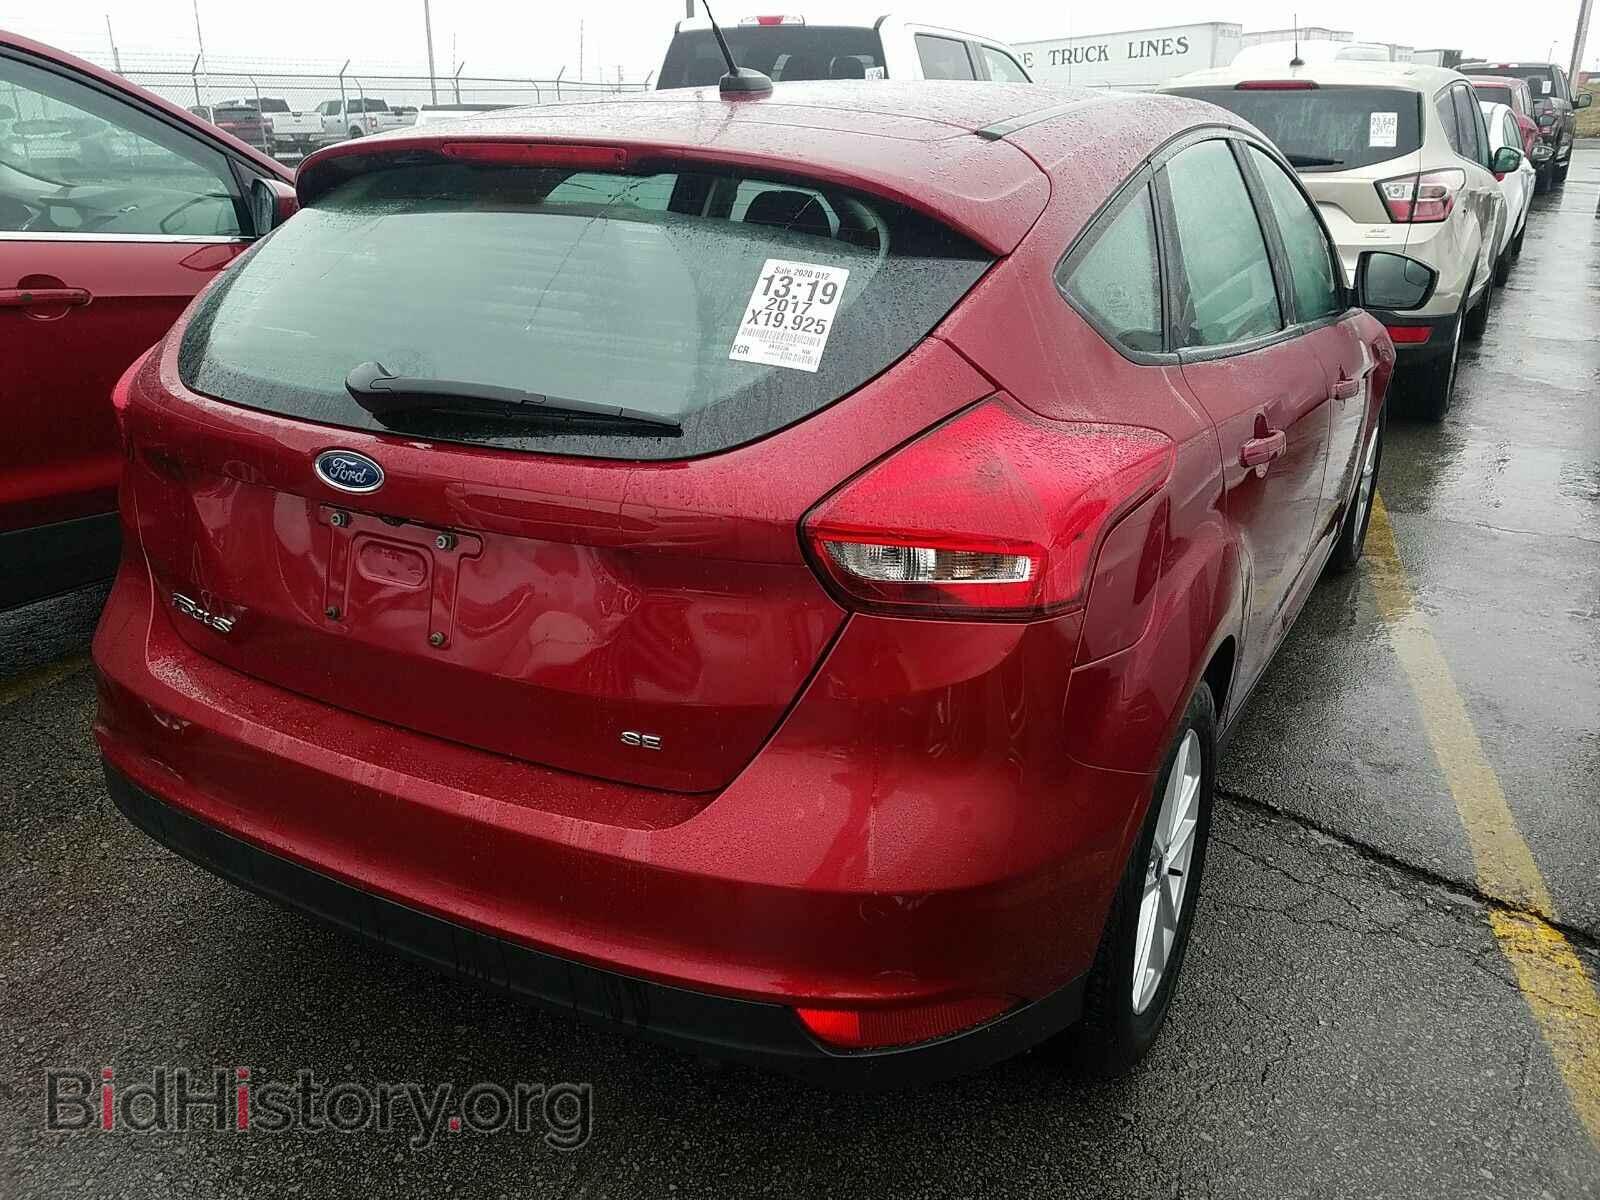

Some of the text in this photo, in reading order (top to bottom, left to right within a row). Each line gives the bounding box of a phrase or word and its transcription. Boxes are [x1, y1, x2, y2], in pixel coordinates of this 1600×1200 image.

[1048, 44, 1110, 66] TRUCK
[1127, 36, 1190, 59] LINES
[774, 266, 792, 275] Sale
[762, 274, 838, 305] 13:19
[765, 297, 812, 315] 2017
[732, 344, 750, 355] FCR
[328, 457, 367, 484] Ford
[172, 592, 234, 633] Focus
[620, 731, 662, 751] SE
